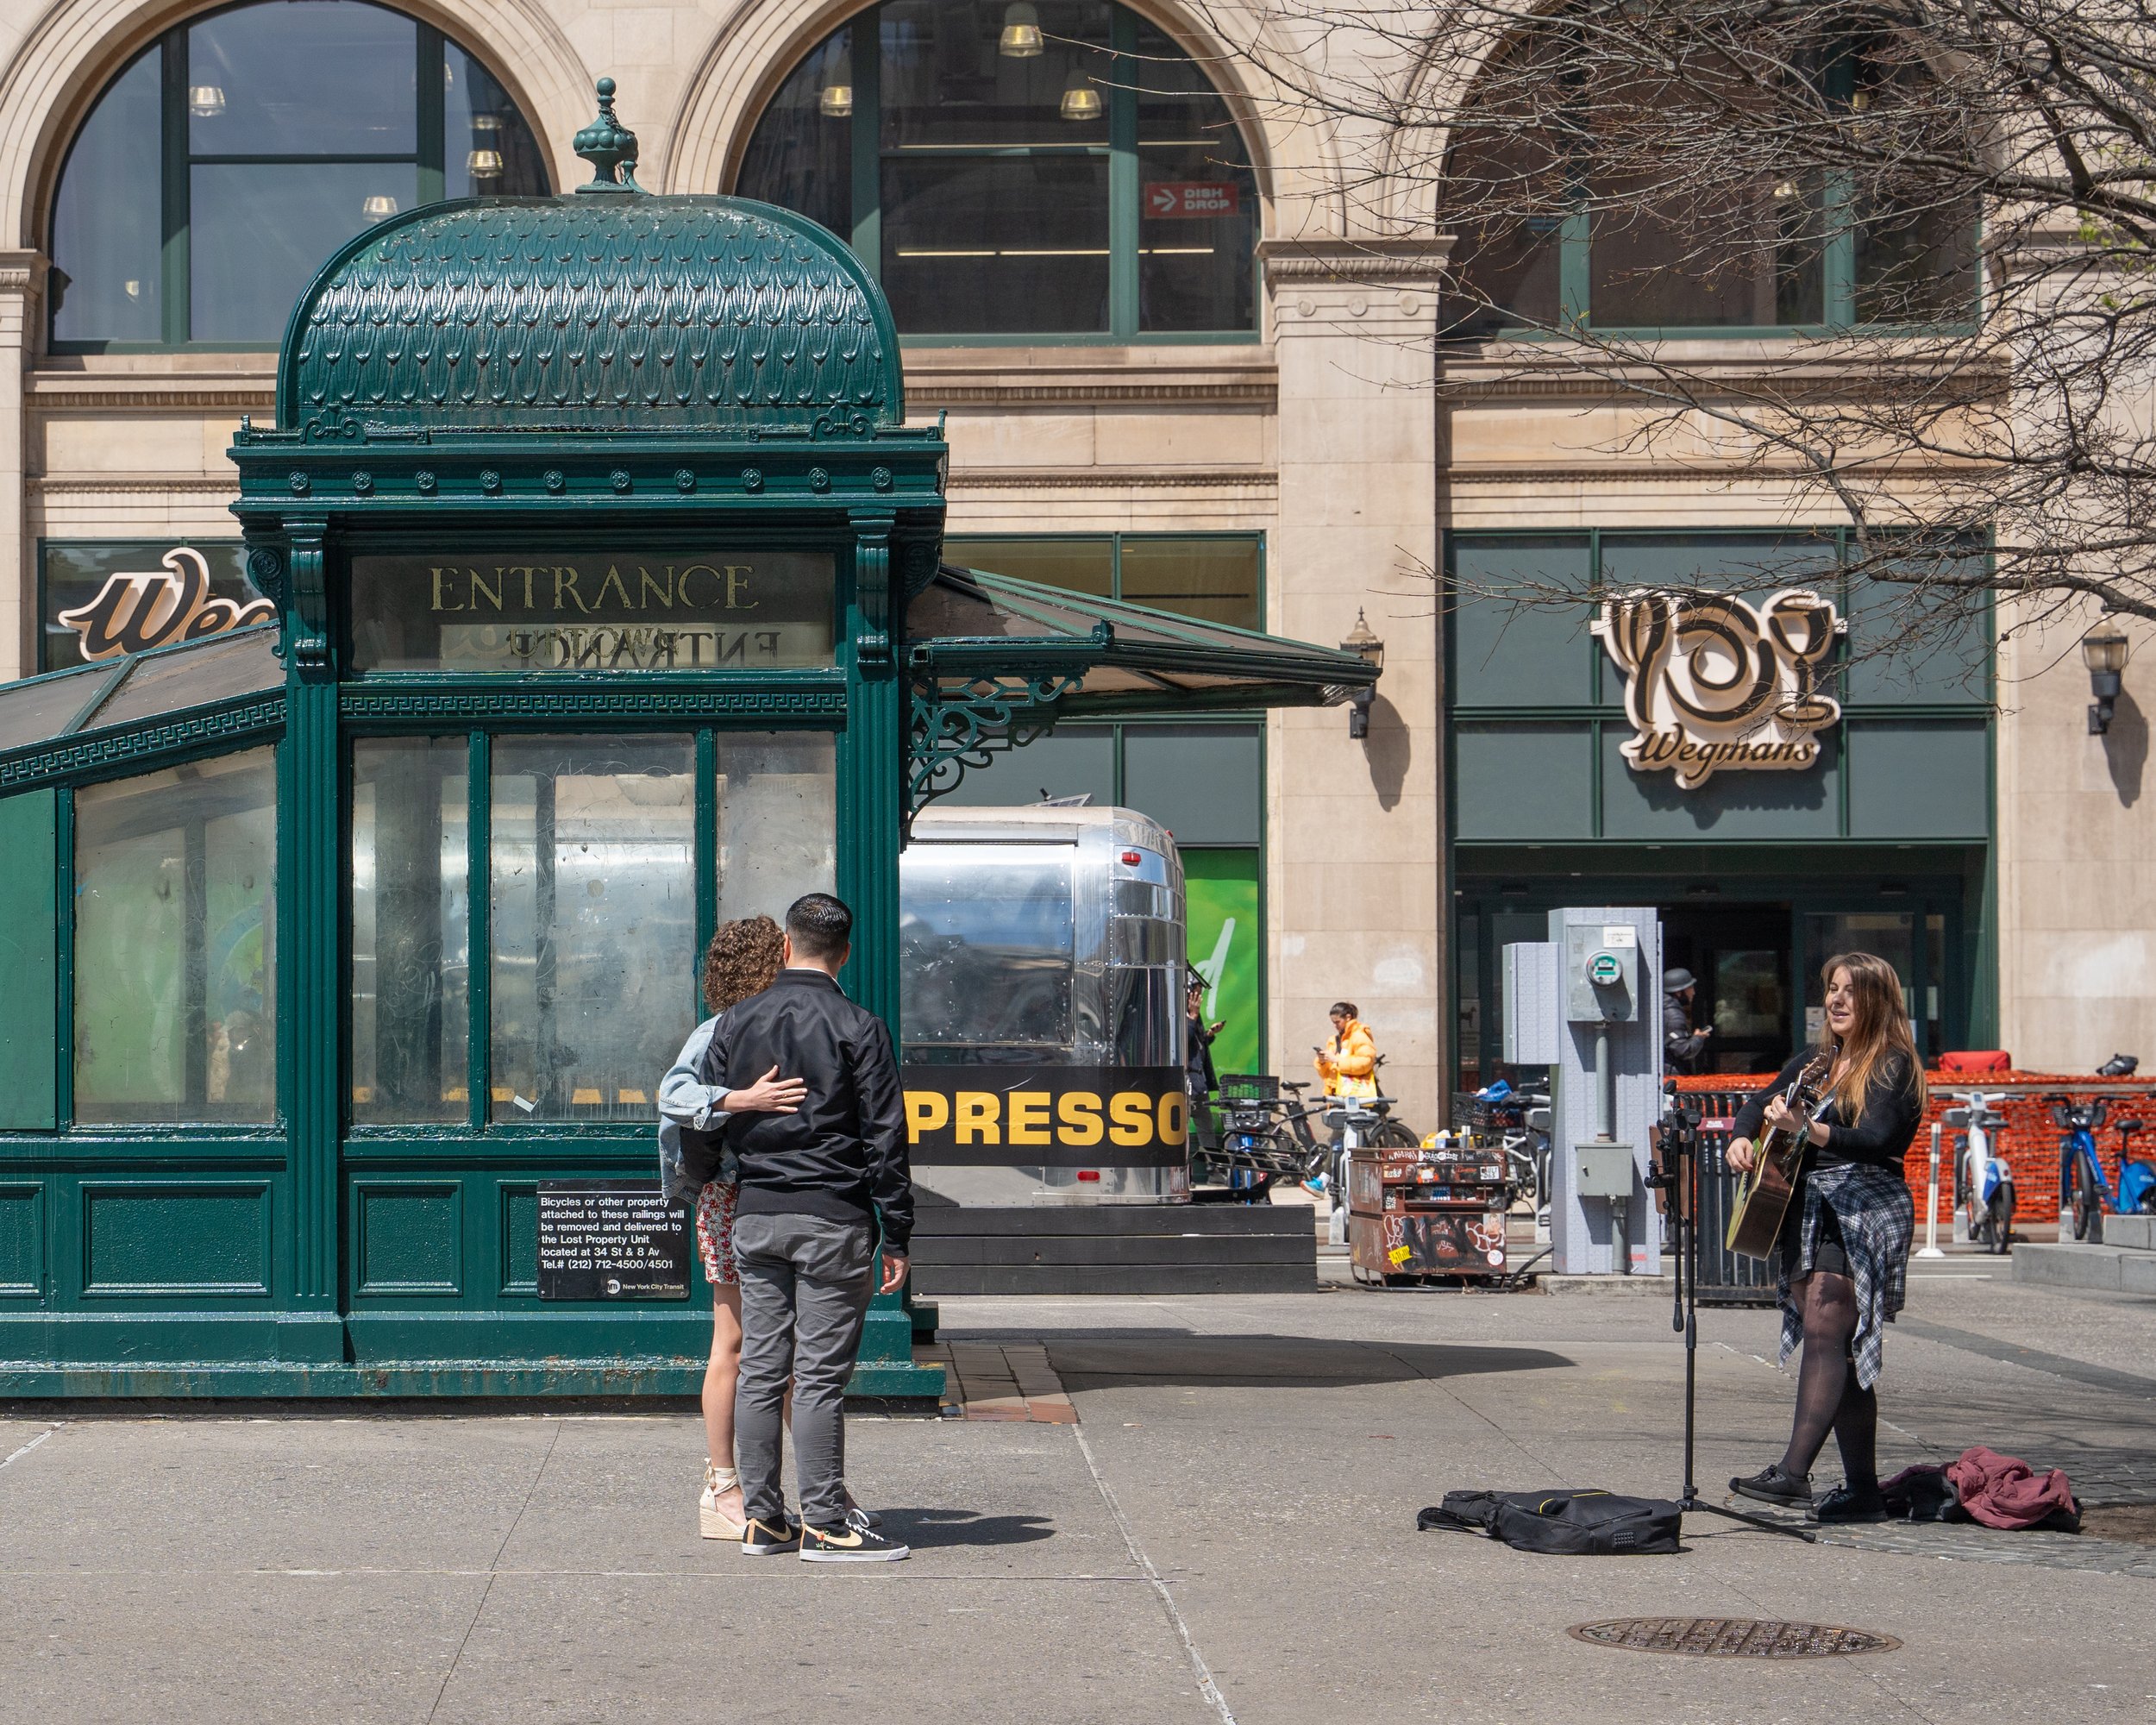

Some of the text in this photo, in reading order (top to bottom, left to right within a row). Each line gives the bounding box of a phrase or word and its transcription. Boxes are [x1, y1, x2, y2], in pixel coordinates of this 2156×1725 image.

[1184, 189, 1223, 198] DISH
[1184, 199, 1231, 210] DROP
[430, 563, 760, 613] ENTRANCE
[509, 627, 680, 658] UPTOWN
[1629, 723, 1814, 781] Wegmans
[904, 1091, 1185, 1146] PRESSO
[541, 1197, 580, 1208] Bicycles
[599, 1197, 624, 1206] other
[628, 1197, 669, 1208] property
[542, 1210, 584, 1219] attached
[602, 1210, 629, 1219] these
[633, 1210, 665, 1220] railings
[557, 1222, 599, 1231] removed
[603, 1222, 620, 1231] and
[624, 1222, 667, 1231] delivered
[542, 1235, 649, 1245] the Lost Property Unit
[542, 1247, 577, 1256] located
[594, 1247, 607, 1256] 34
[611, 1247, 622, 1256] St
[637, 1247, 644, 1256] 8
[542, 1259, 672, 1270] Tel.# (212) 712-4500/4501
